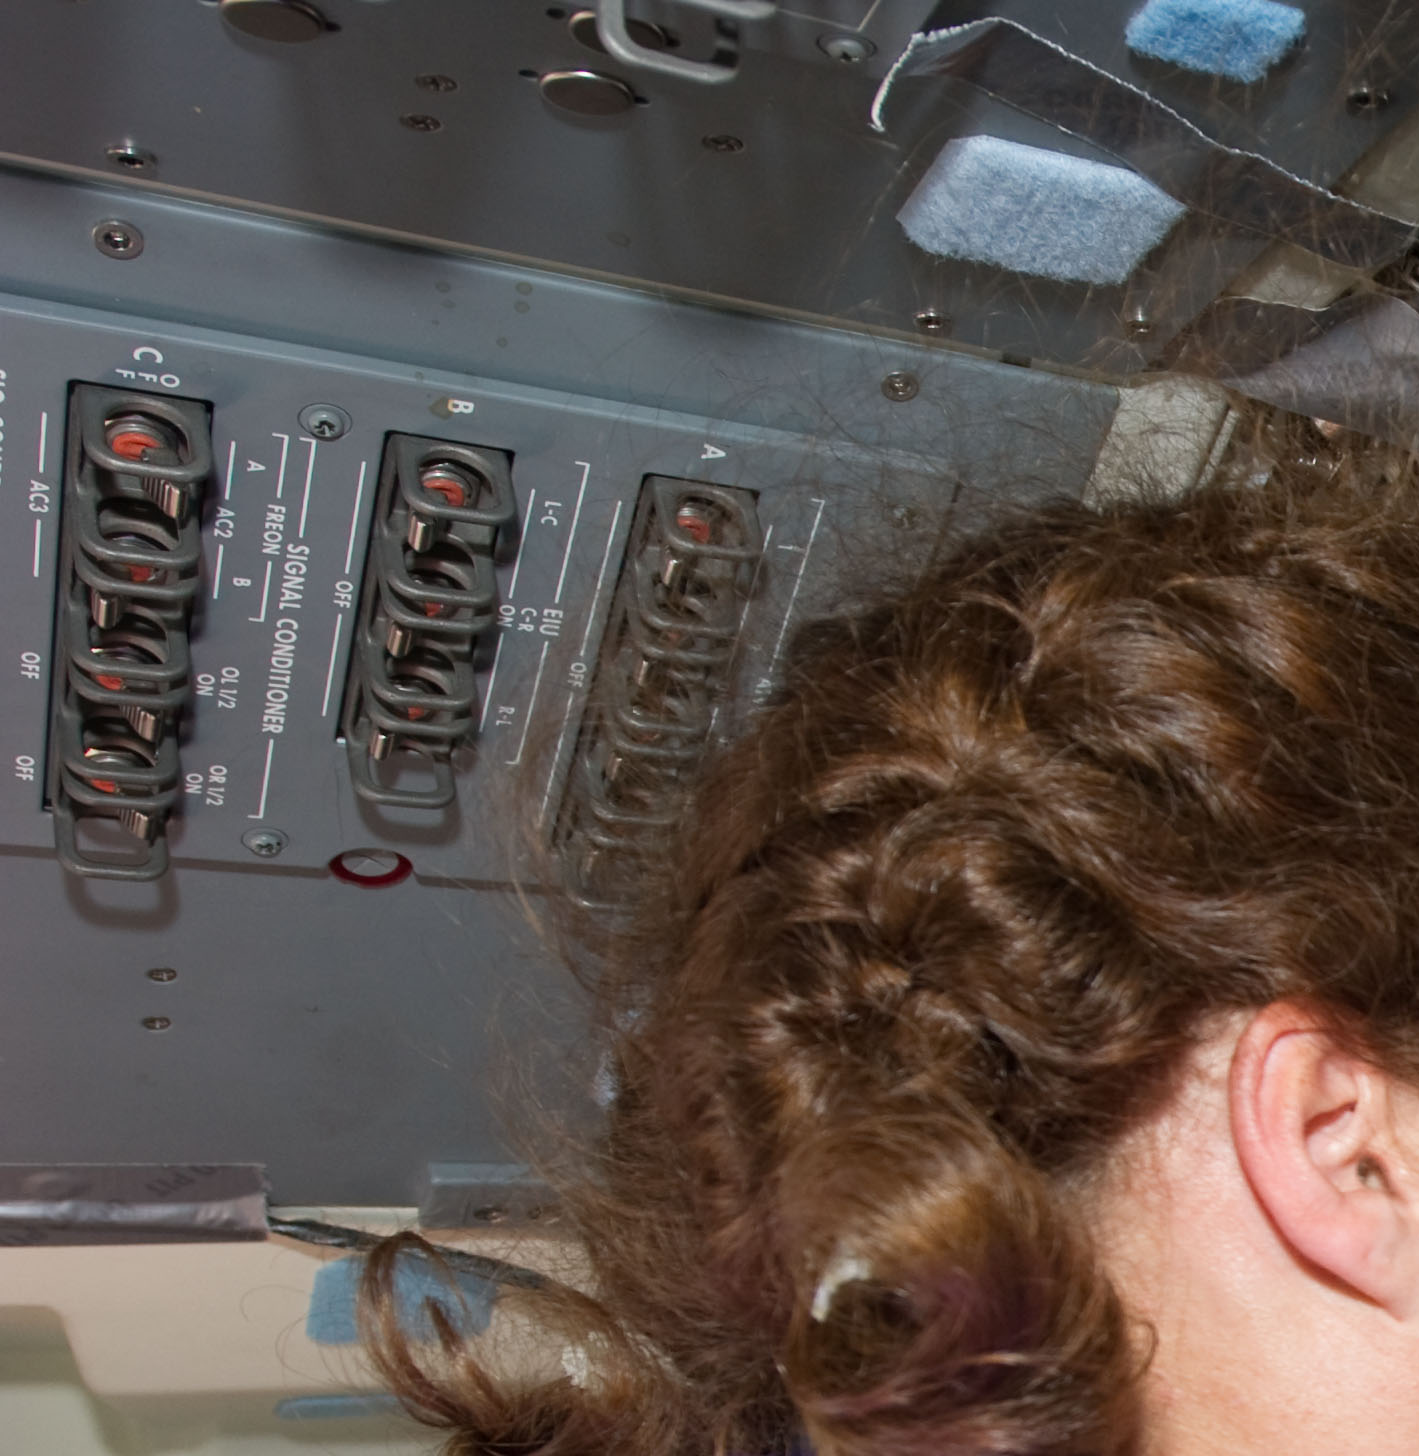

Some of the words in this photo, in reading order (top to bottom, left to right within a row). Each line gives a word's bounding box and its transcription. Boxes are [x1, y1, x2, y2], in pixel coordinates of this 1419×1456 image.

[133, 347, 163, 364] C
[448, 399, 475, 414] B
[701, 443, 726, 460] A
[247, 460, 266, 472] A
[29, 480, 50, 513] AC3
[213, 507, 235, 538] AC2
[540, 500, 562, 526] L-C
[262, 504, 286, 555] FREON
[233, 577, 251, 586] B
[278, 543, 310, 611] SIGNAL
[333, 580, 353, 608] OFF
[497, 604, 515, 628] ON
[517, 608, 537, 632] C-R
[539, 608, 563, 636] EIU
[21, 652, 40, 679] OFF
[221, 666, 240, 686] OL
[262, 618, 298, 734] CONDITIONER
[196, 674, 214, 697] ON
[217, 688, 236, 709] 1/2
[15, 755, 35, 781] OFF
[209, 765, 228, 784] OR
[185, 773, 203, 793] ON
[206, 786, 225, 806] 1/2
